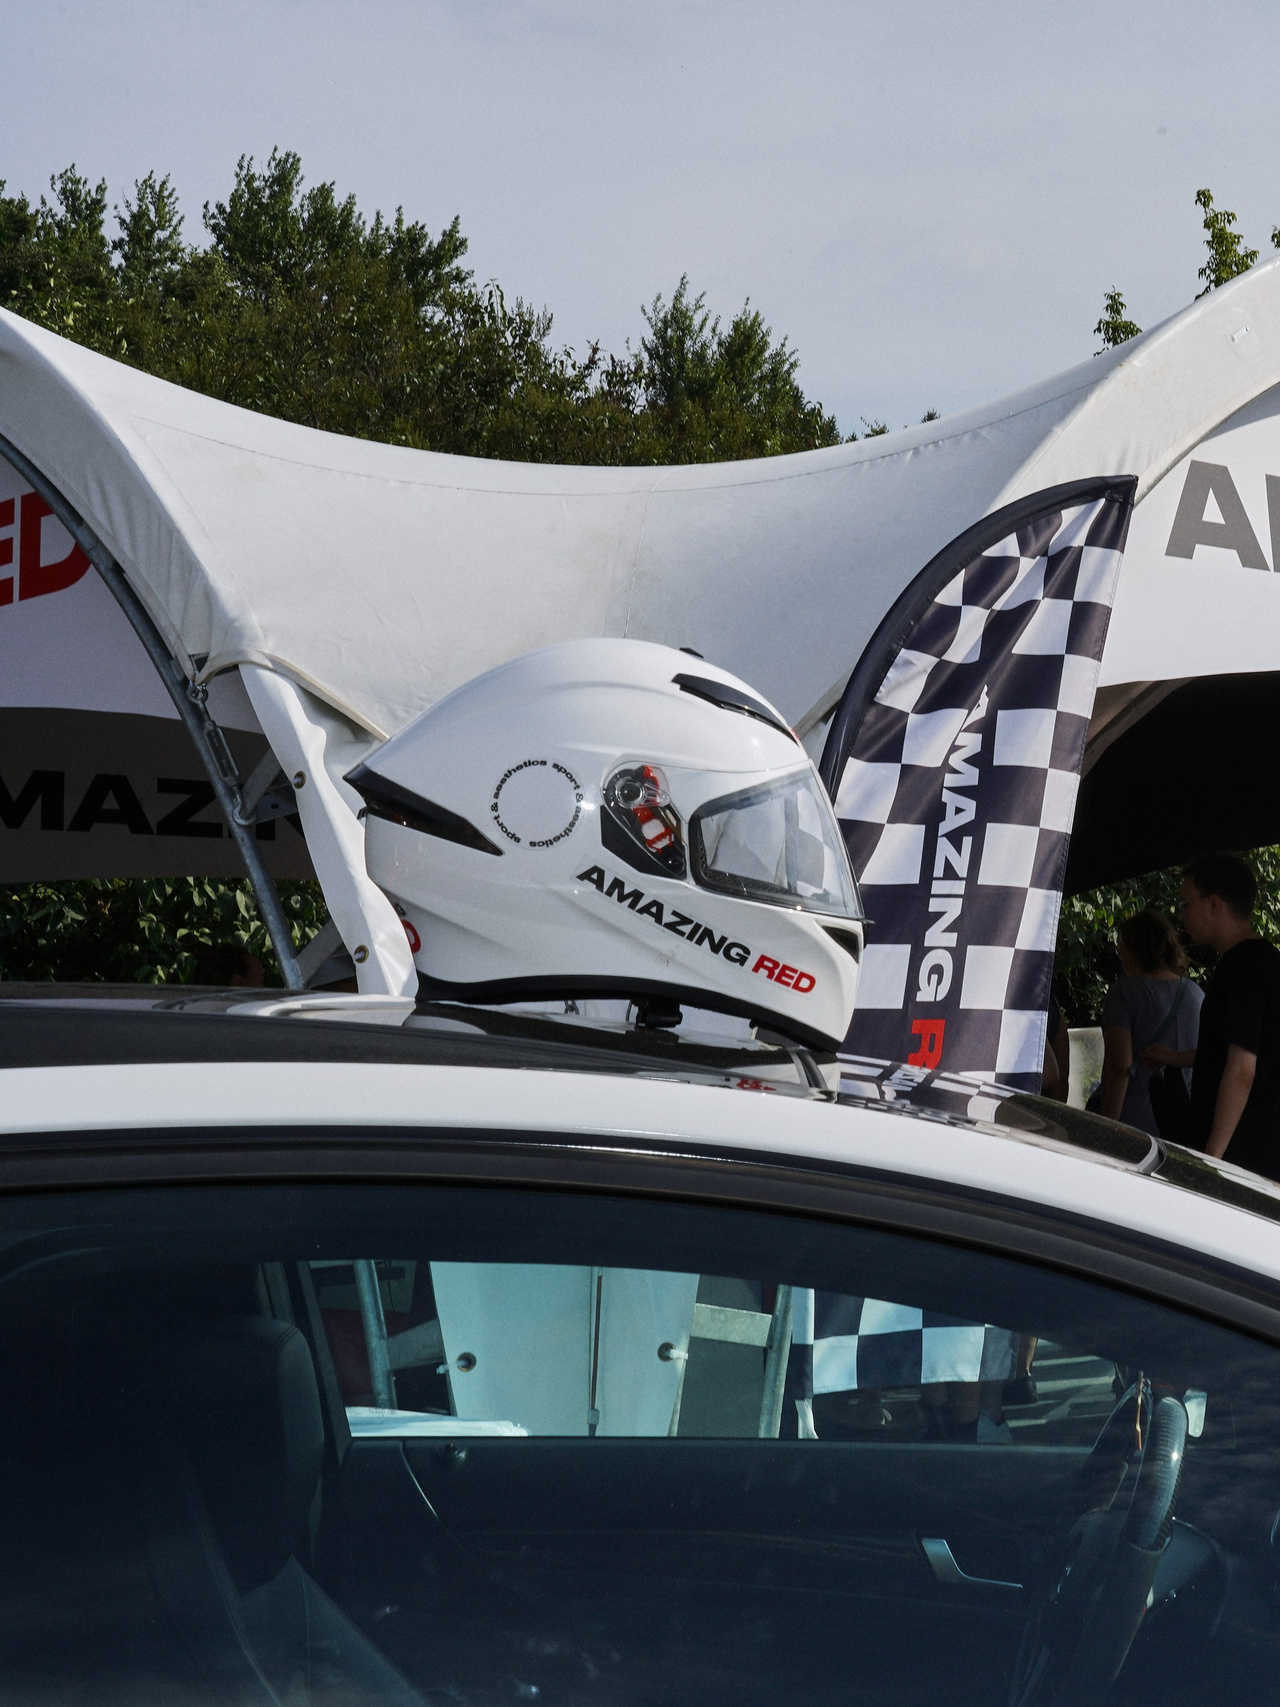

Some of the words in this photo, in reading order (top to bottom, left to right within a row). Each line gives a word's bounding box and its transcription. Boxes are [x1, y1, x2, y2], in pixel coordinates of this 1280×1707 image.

[493, 759, 548, 800] aesthetics
[552, 762, 581, 791] sport
[493, 814, 522, 844] sport
[529, 806, 582, 848] aesthetics
[915, 684, 989, 1002] AMAZING
[576, 865, 751, 967] AMAZING
[751, 954, 817, 994] RED
